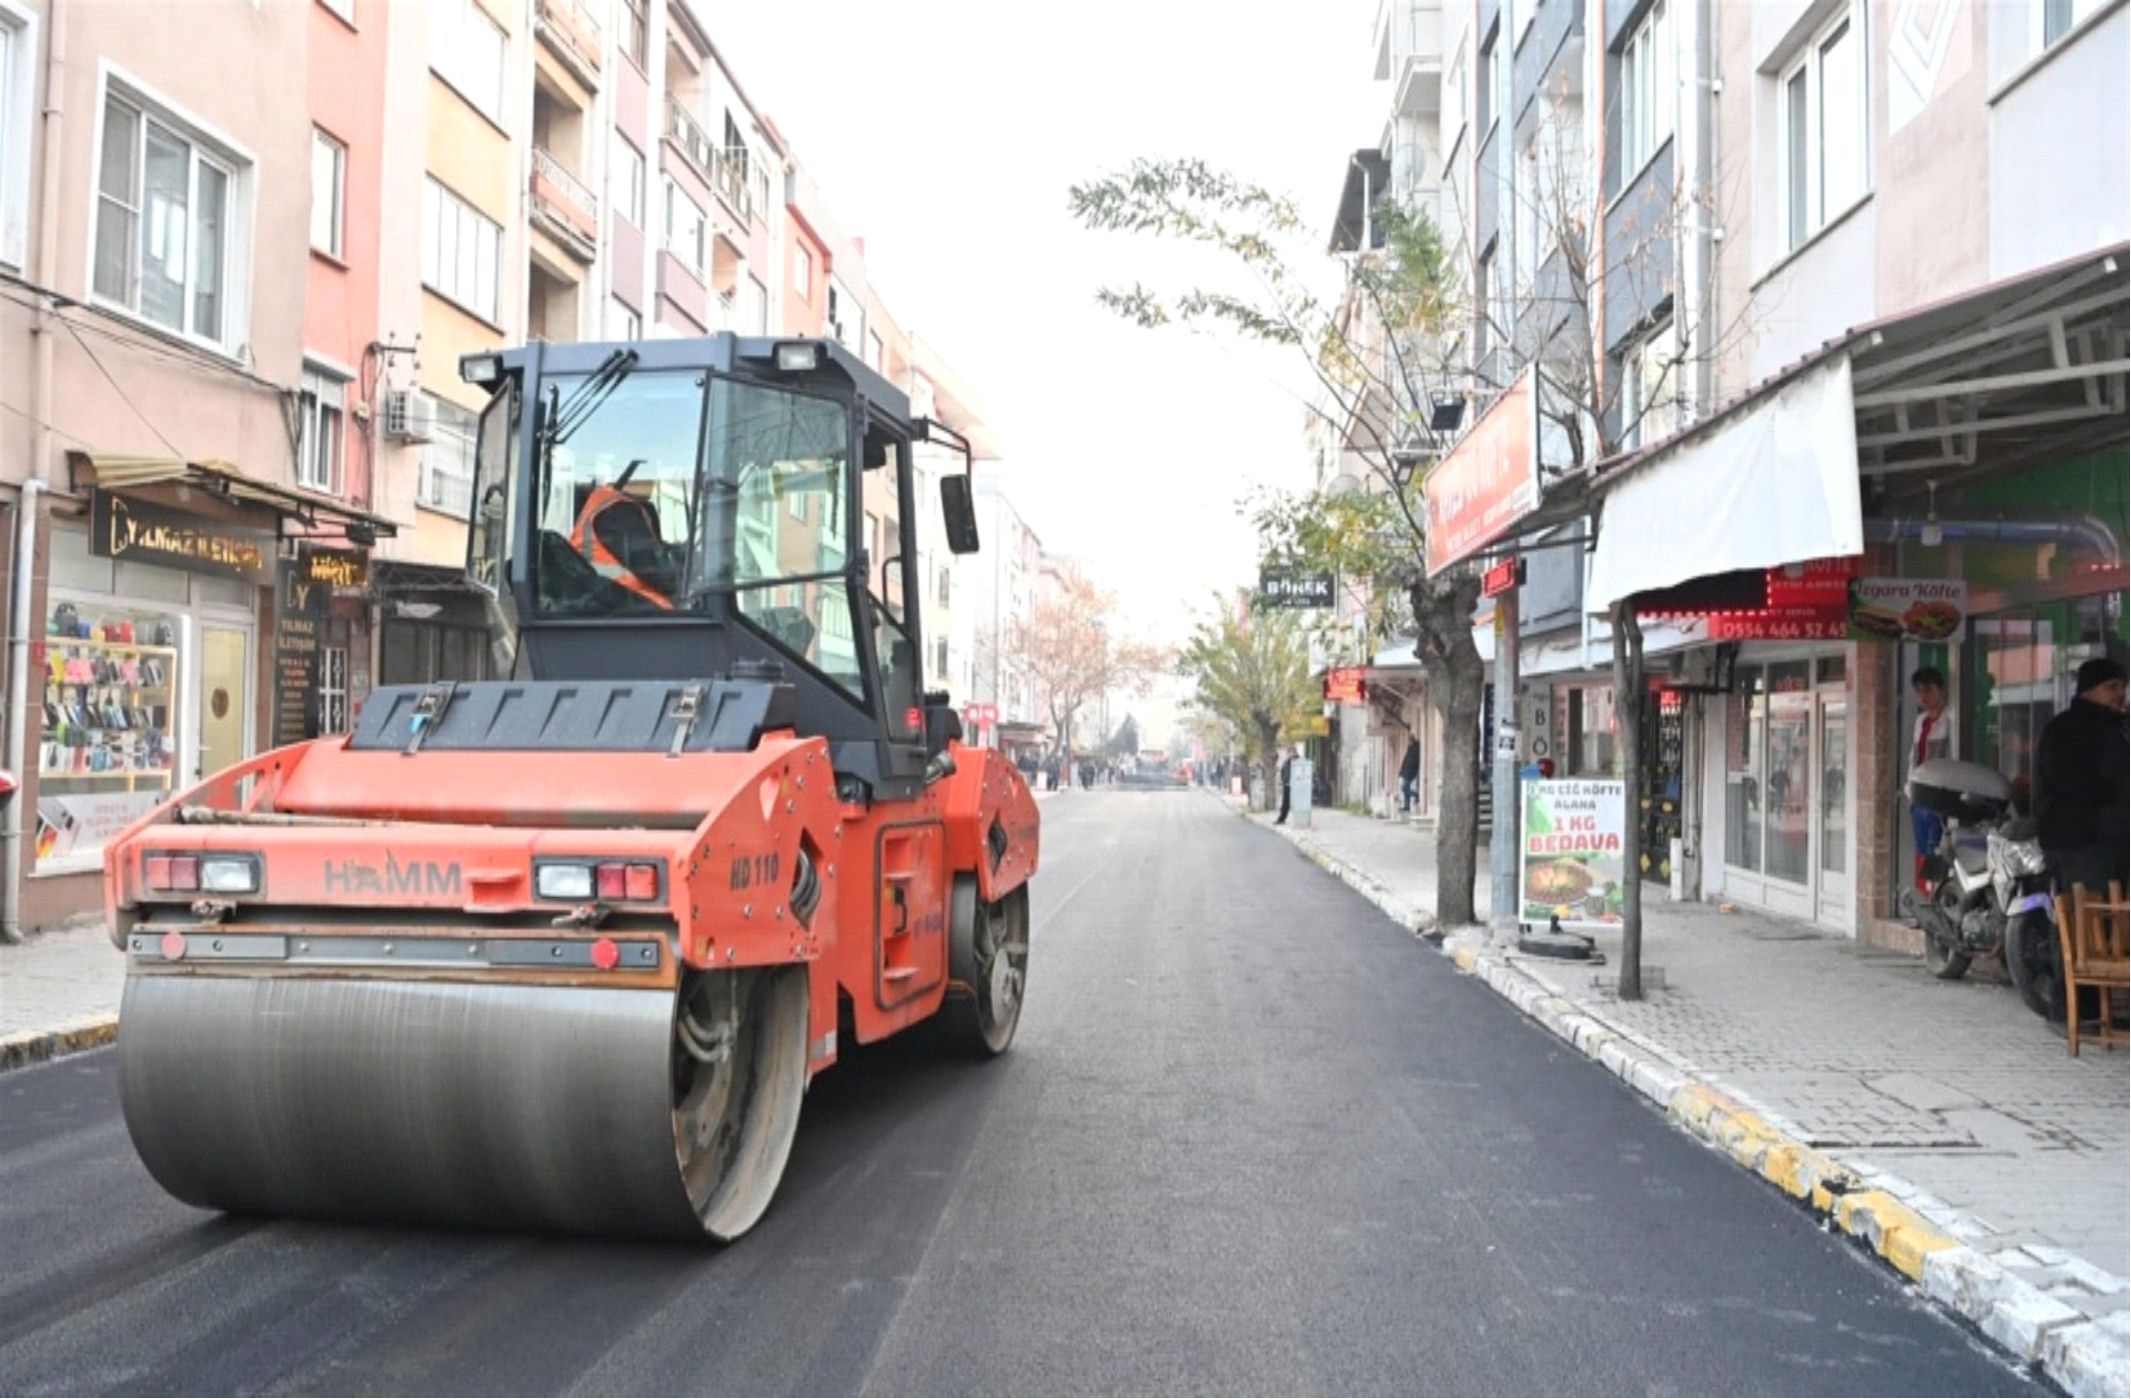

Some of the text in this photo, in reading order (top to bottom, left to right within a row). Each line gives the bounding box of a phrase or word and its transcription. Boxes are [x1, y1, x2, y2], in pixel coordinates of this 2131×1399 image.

[1555, 817, 1564, 831] 1
[1530, 832, 1620, 852] BEDAVA
[324, 859, 462, 894] HAMM
[731, 853, 779, 890] HD 110
